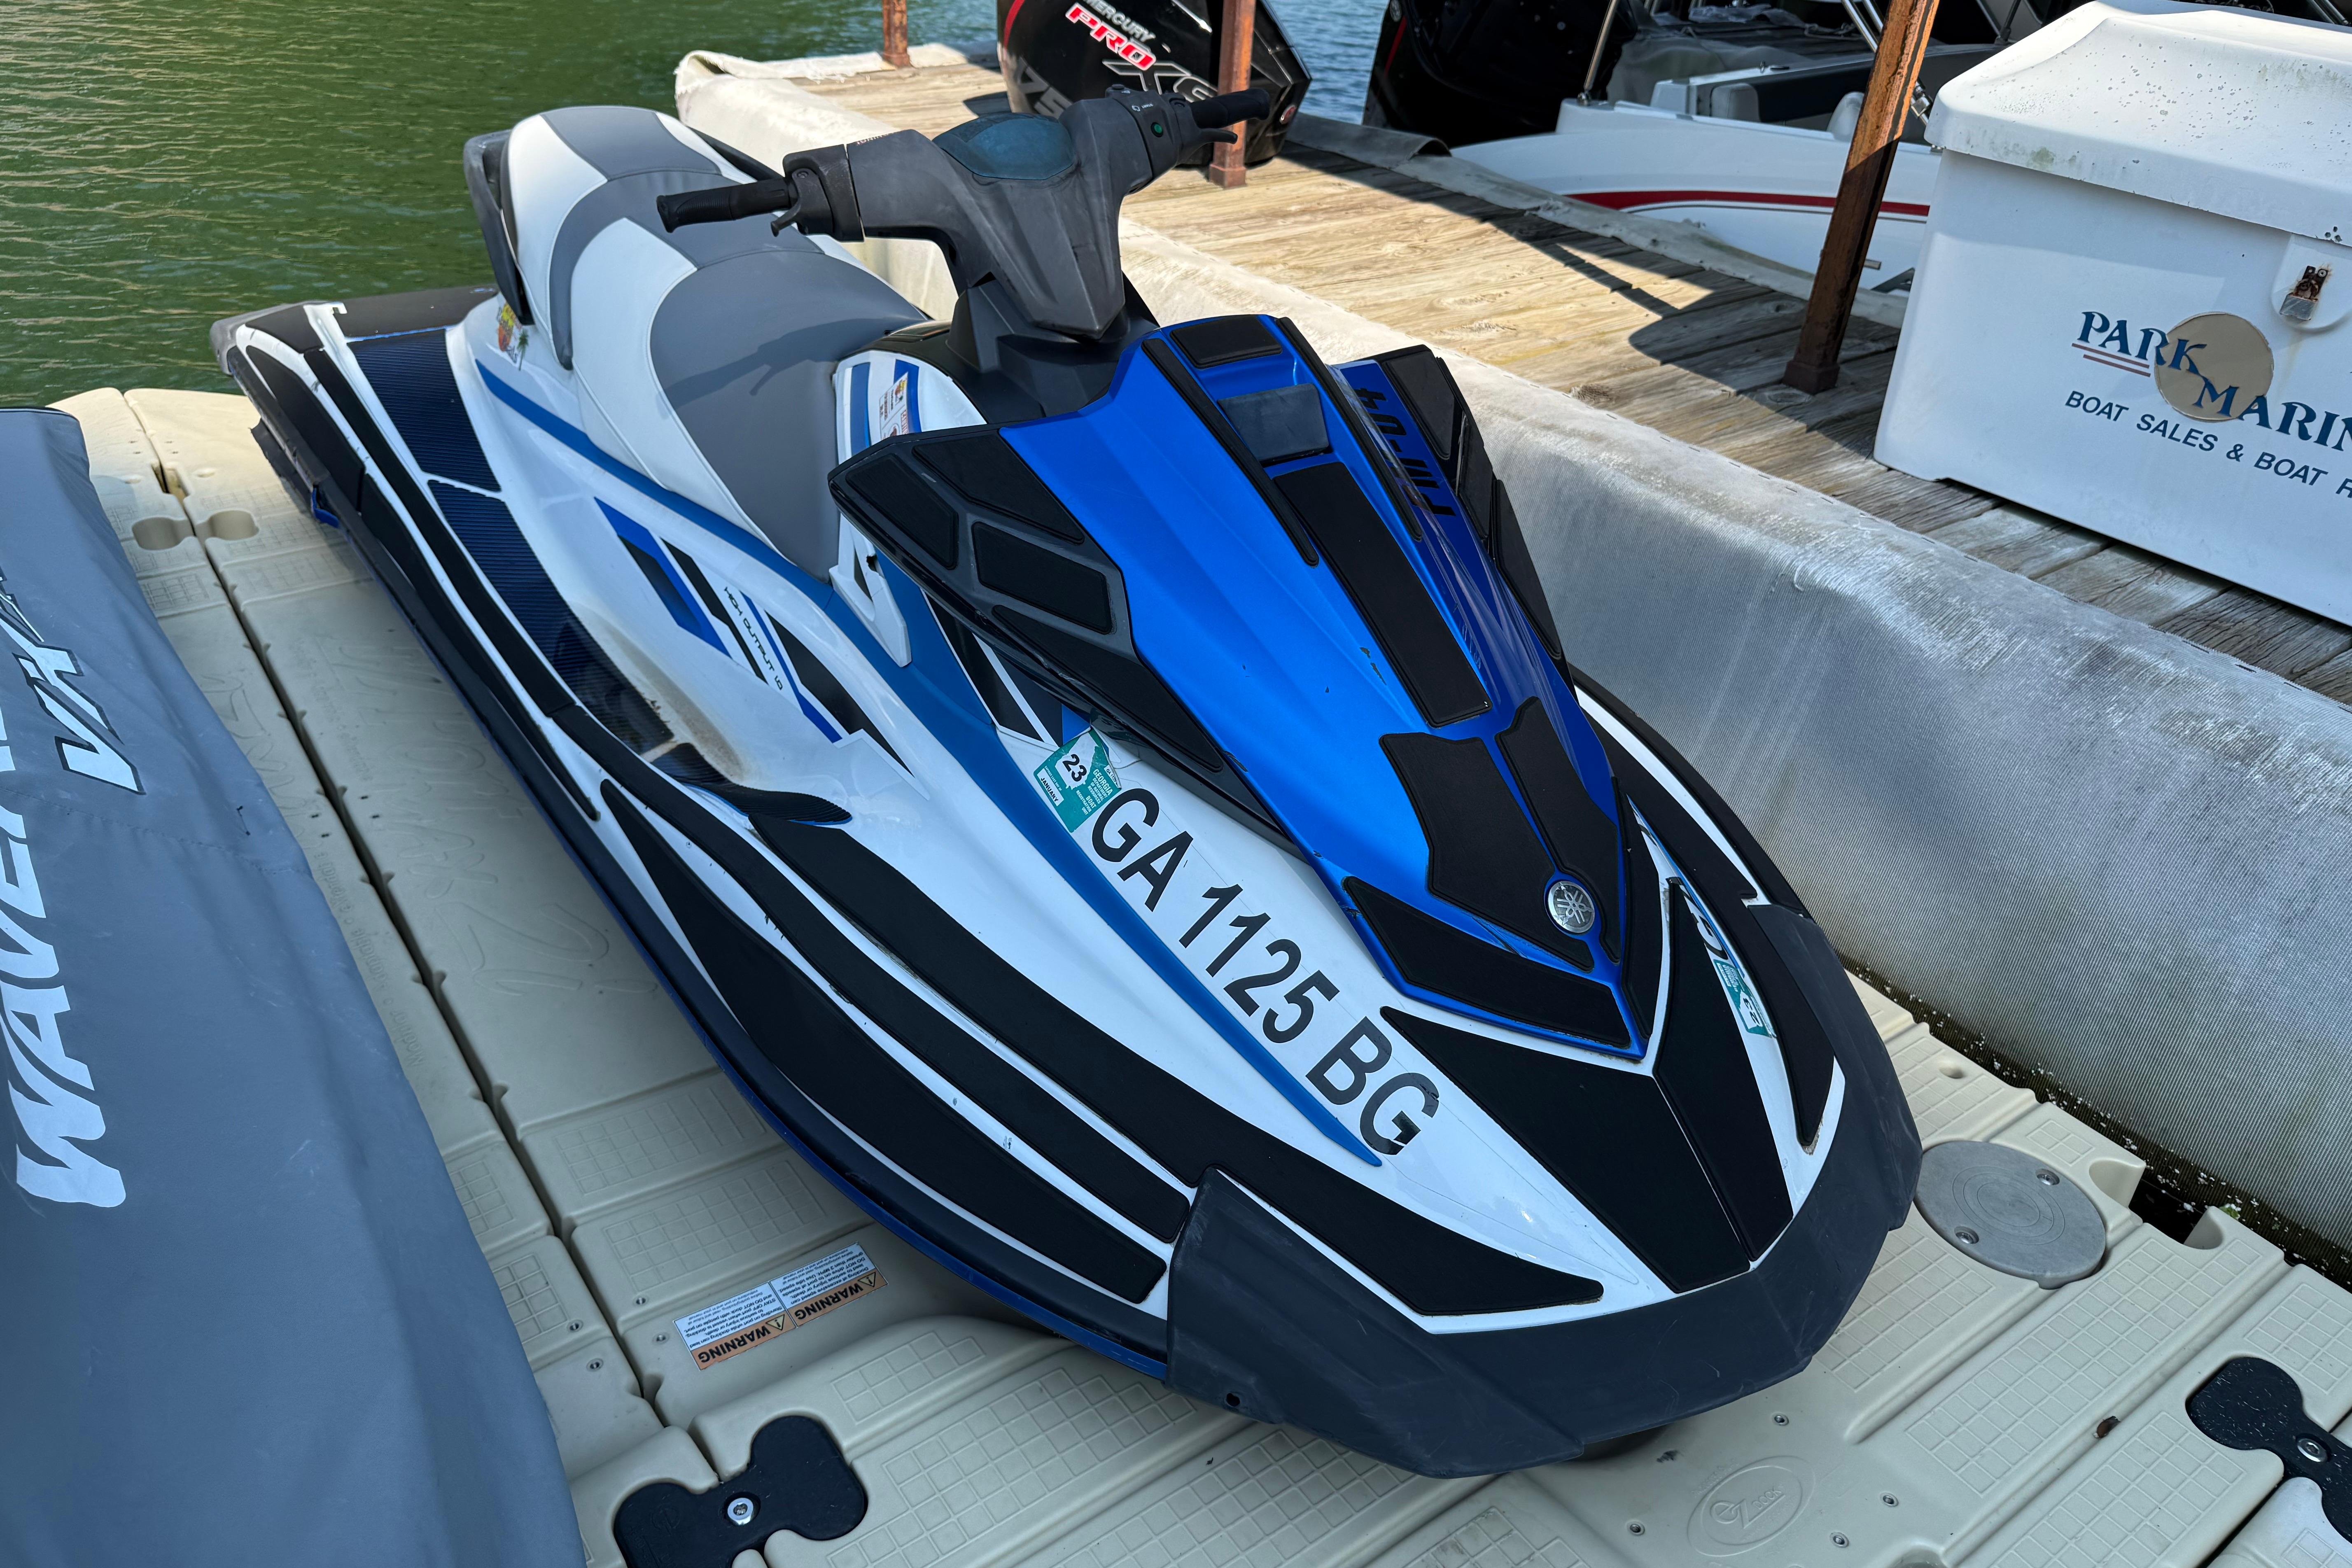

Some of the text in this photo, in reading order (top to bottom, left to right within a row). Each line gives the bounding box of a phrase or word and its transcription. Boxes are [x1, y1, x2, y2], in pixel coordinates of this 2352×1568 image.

[1083, 0, 1156, 42] MERCURY
[1065, 2, 1156, 70] PRO
[2077, 311, 2207, 375] PARK
[2065, 390, 2129, 422] BOAT
[2137, 413, 2218, 452] SALES
[2226, 444, 2243, 462] &
[2254, 452, 2329, 486] BOAT
[724, 586, 743, 616] HIGH
[743, 618, 775, 671] OUTPUT
[1062, 754, 1087, 782] 23
[1092, 768, 1113, 796] GEORGIA
[1092, 777, 1108, 798] DEPARTMENT
[1040, 777, 1059, 803] JANUARY
[1087, 785, 1101, 805] RESOURCES
[1093, 786, 1104, 801] NATURAL
[1076, 789, 1092, 812] REGISTRATION
[1085, 795, 1097, 810] BOAT
[1092, 788, 1439, 1156] GA 1125 BG
[1743, 997, 1760, 1026] 23
[845, 1251, 863, 1262] greater
[827, 1271, 847, 1282] serious
[831, 1266, 845, 1275] drive
[847, 1266, 869, 1279] Docking
[806, 1278, 818, 1286] port
[812, 1279, 828, 1289] injury
[817, 1279, 842, 1293] excessive
[782, 1286, 801, 1297] speeds
[800, 1290, 817, 1300] speed
[762, 1297, 776, 1306] STAY
[795, 1283, 863, 1319] WARNING
[728, 1312, 742, 1321] when
[739, 1311, 758, 1321] serious
[760, 1305, 782, 1318] Standing
[702, 1315, 720, 1326] people
[712, 1318, 728, 1328] vessel
[724, 1318, 740, 1328] injury
[730, 1323, 744, 1331] while
[709, 1328, 730, 1340] docking
[698, 1325, 771, 1363] WARNING
[1751, 1486, 1782, 1510] DOCK
